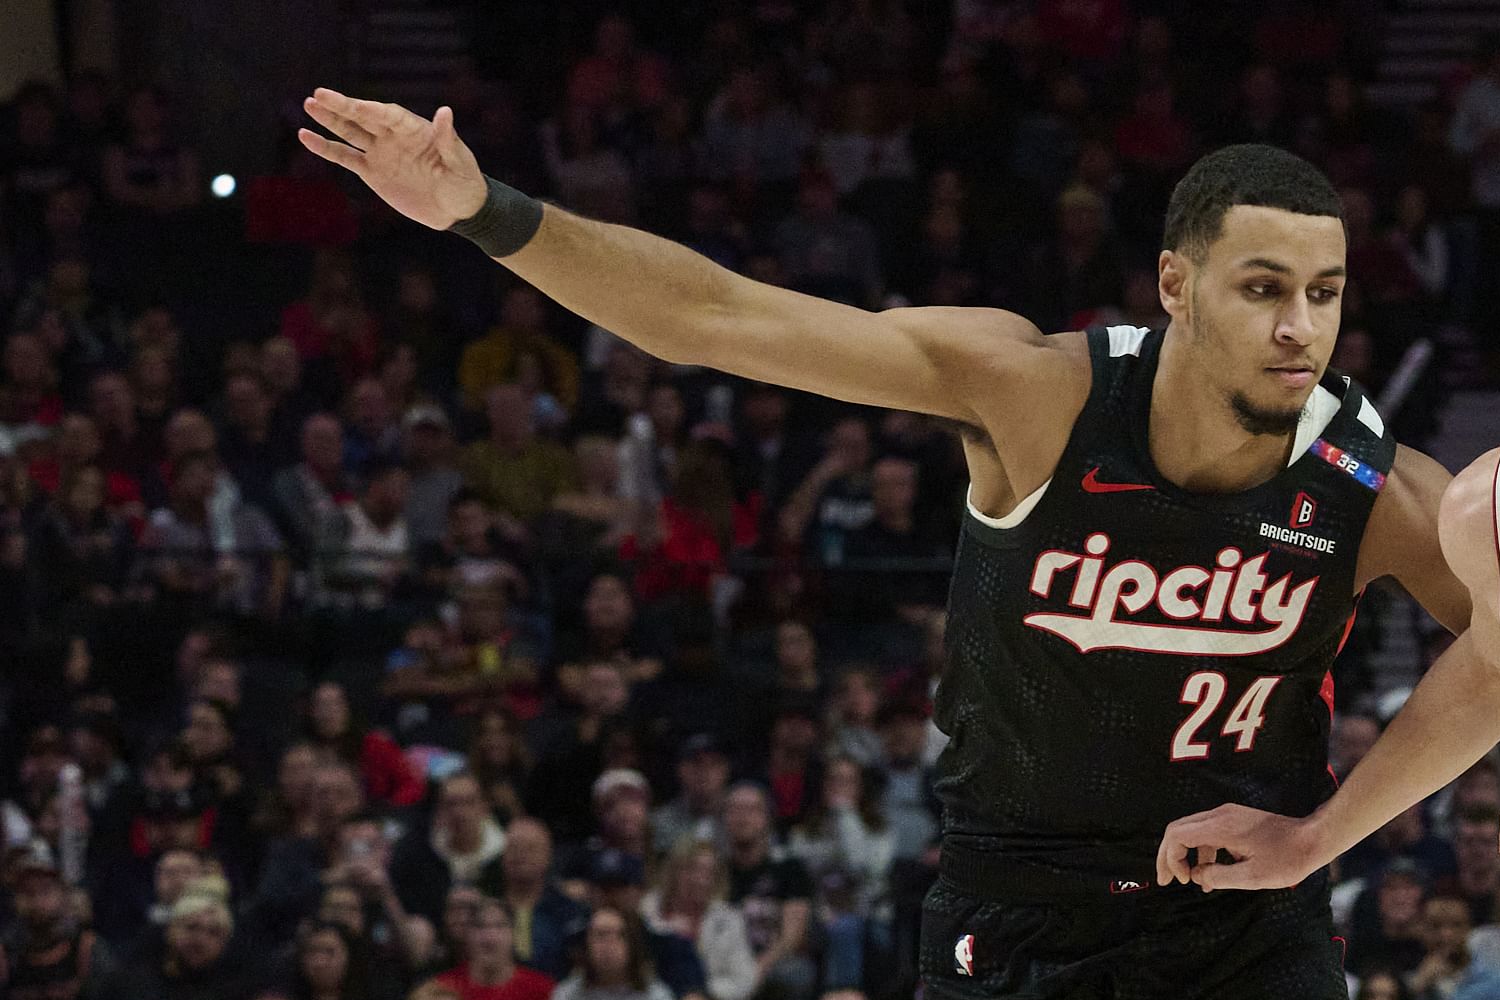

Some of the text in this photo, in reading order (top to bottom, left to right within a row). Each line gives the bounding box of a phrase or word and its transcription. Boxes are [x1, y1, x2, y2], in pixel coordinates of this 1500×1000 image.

[1337, 454, 1360, 475] 32
[1260, 522, 1336, 554] BRIGHTSIDE
[1023, 531, 1320, 656] ripcity
[1170, 669, 1285, 762] 24
